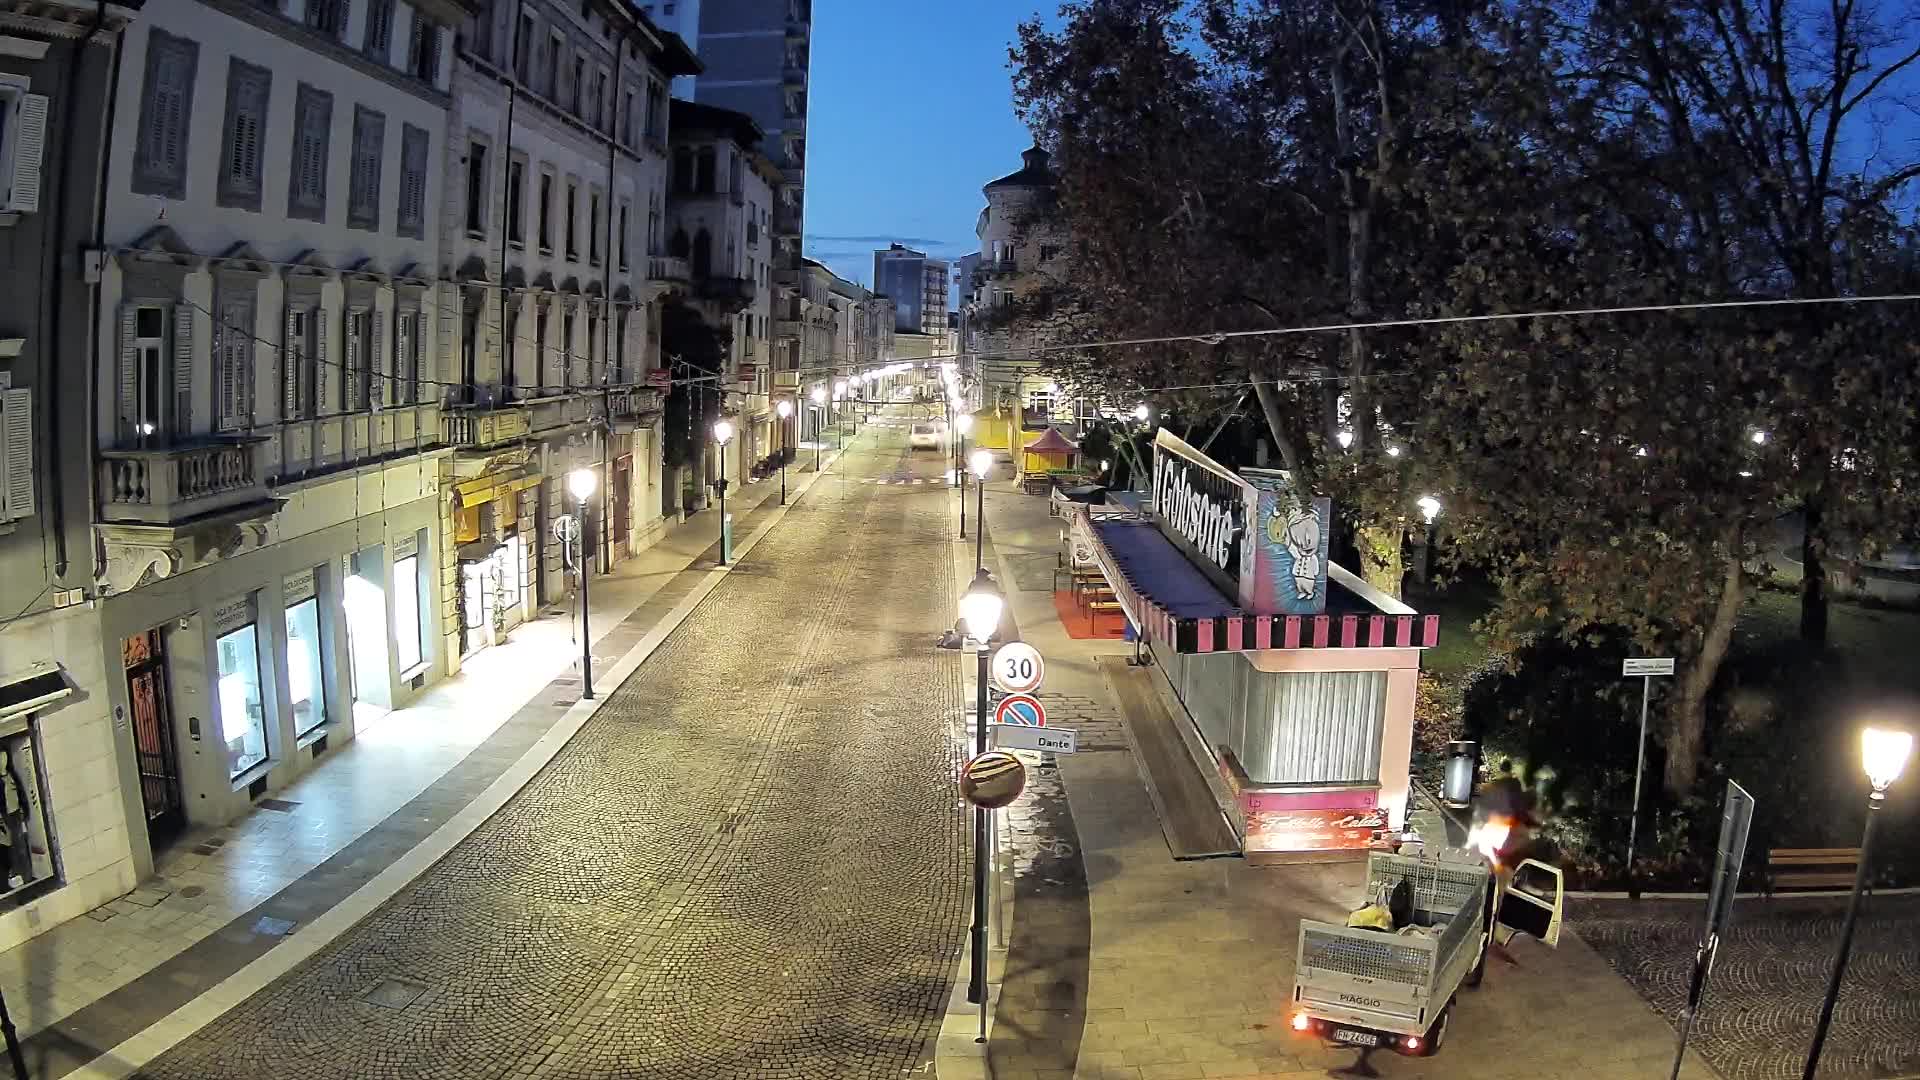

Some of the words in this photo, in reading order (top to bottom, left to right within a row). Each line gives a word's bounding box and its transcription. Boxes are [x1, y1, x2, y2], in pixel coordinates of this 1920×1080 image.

[1162, 458, 1232, 569] Golosone
[1006, 658, 1032, 679] 30
[1038, 737, 1070, 750] Dante
[1340, 994, 1381, 1008] PIAGGIO
